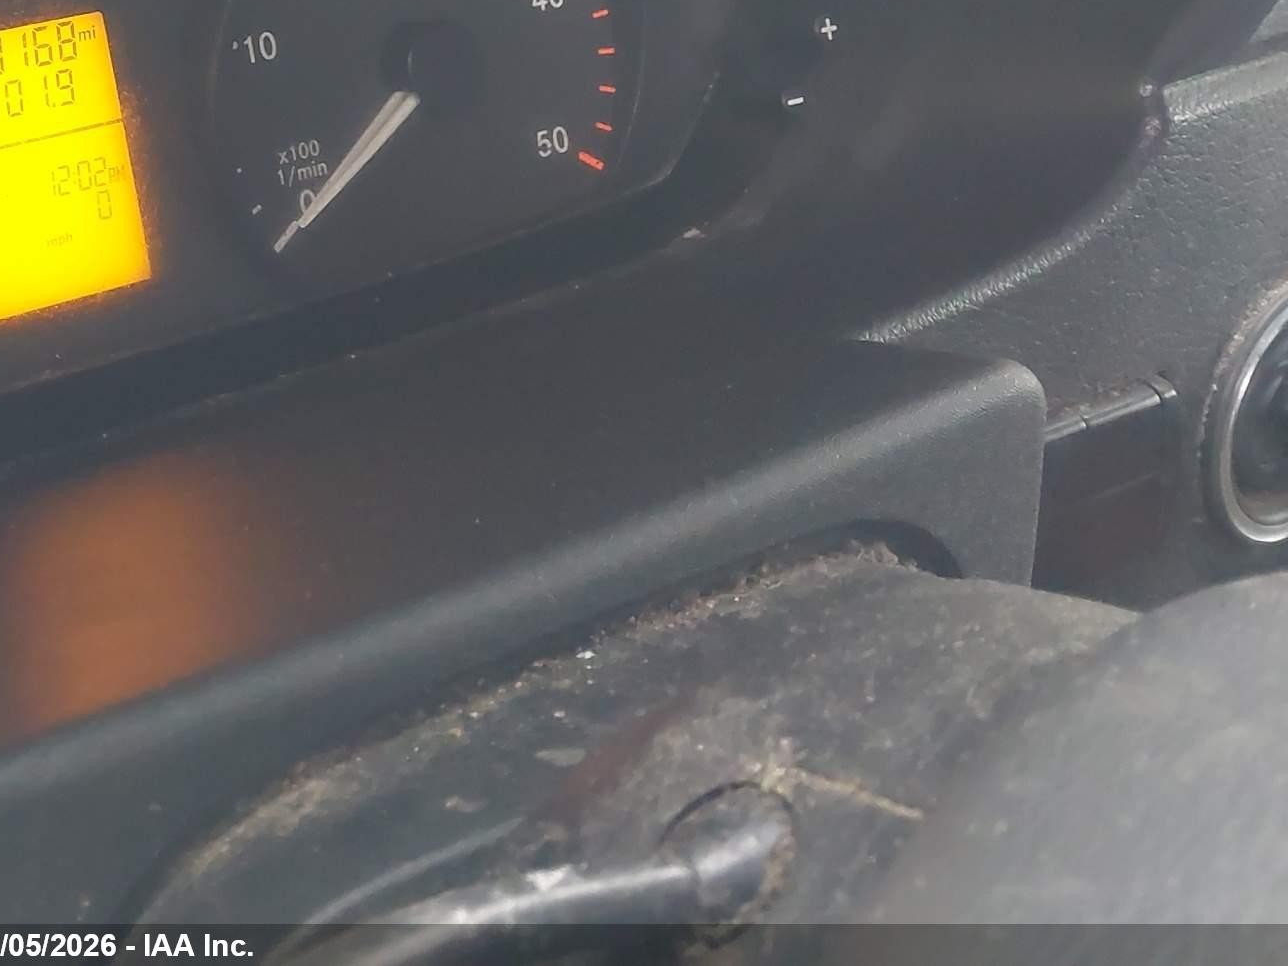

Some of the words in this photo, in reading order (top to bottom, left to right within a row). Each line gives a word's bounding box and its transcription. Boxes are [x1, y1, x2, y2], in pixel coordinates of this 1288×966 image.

[78, 25, 97, 43] mi
[243, 31, 278, 64] 10
[278, 139, 321, 165] x100
[536, 126, 570, 158] 50
[52, 157, 107, 197] 12:02
[277, 158, 328, 186] 1/min
[96, 190, 113, 220] 0
